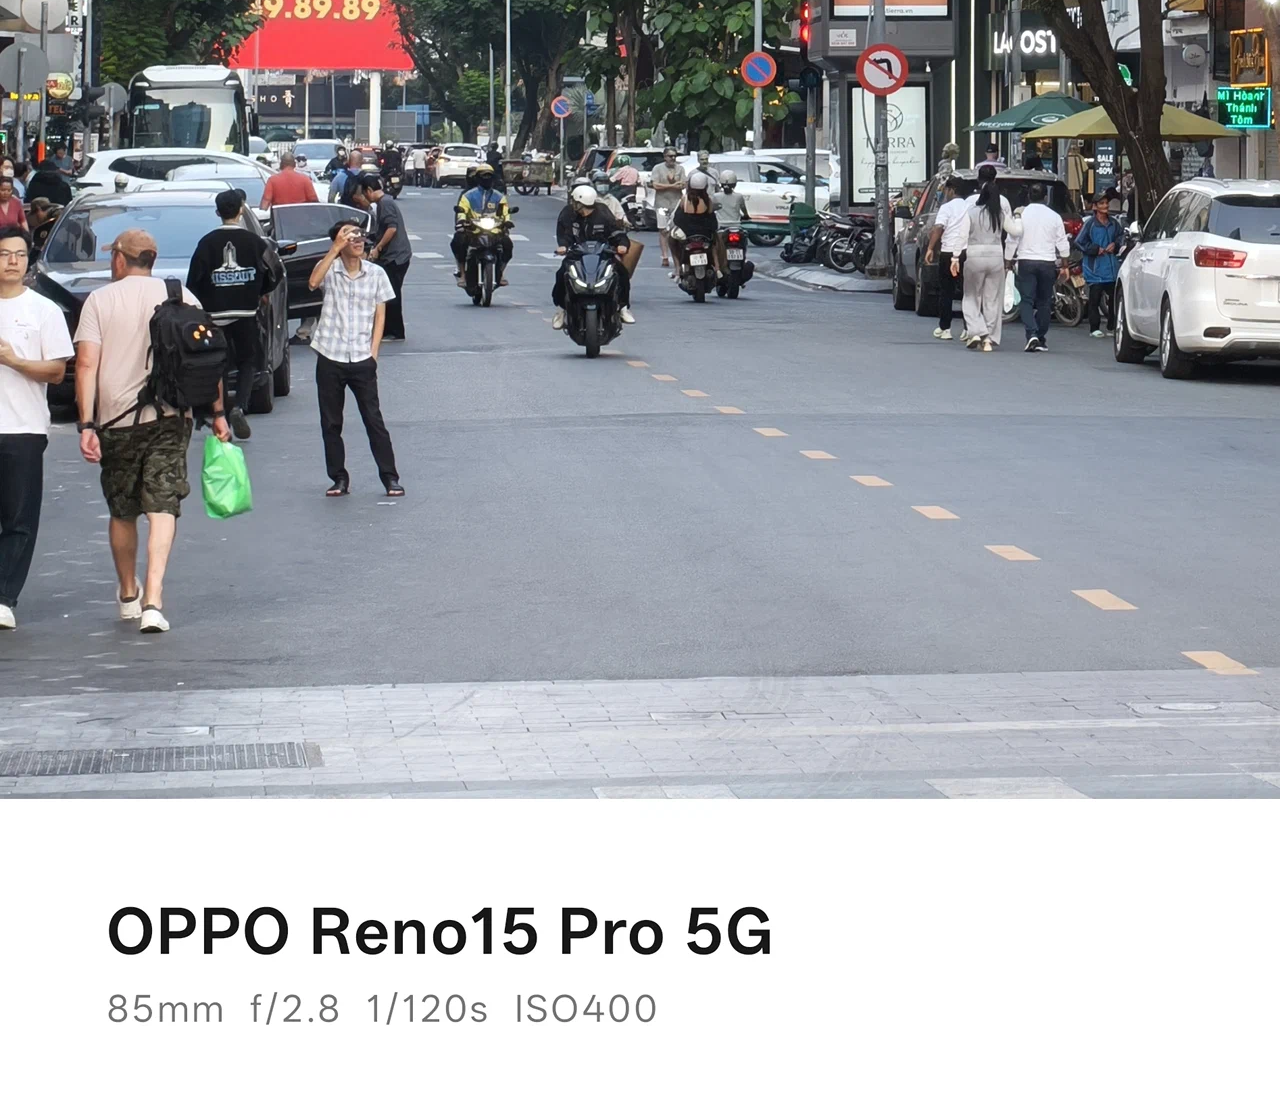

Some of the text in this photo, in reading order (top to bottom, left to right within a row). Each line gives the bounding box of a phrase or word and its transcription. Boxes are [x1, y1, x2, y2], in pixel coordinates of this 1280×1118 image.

[993, 30, 1057, 54] LAOST
[862, 136, 916, 148] TRRA
[1097, 154, 1113, 162] SALE
